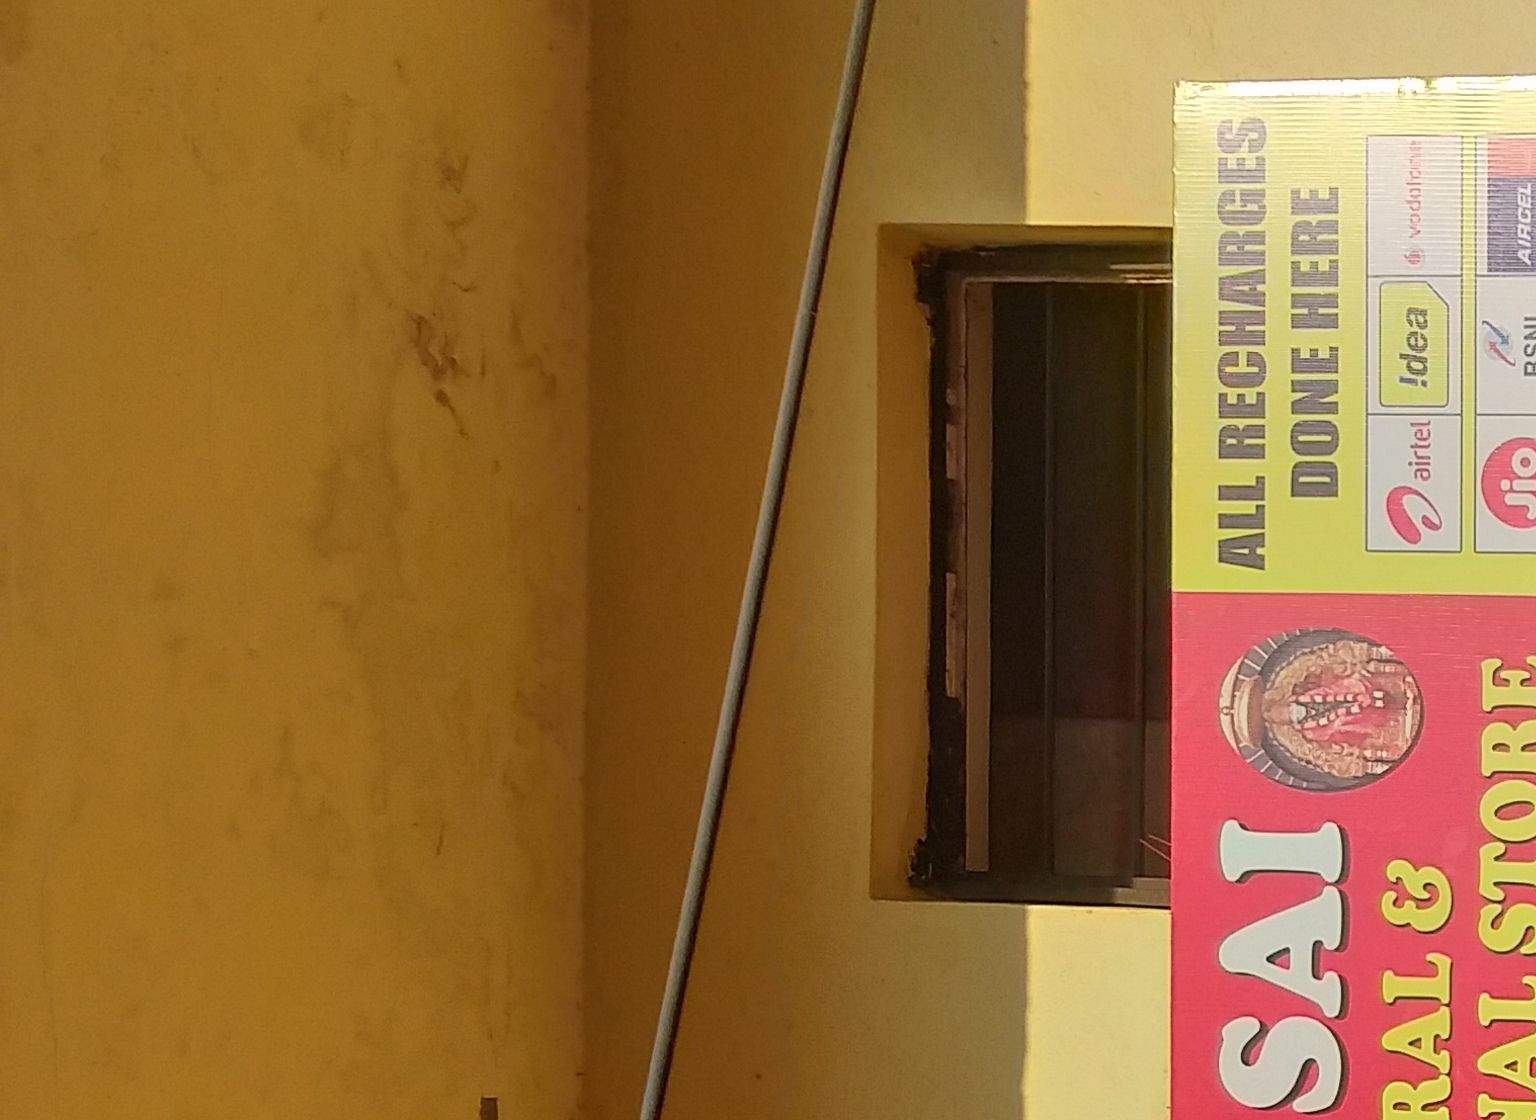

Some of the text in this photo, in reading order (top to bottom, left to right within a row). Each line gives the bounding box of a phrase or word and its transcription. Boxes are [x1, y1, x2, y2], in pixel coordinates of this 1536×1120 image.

[1404, 140, 1423, 239] vodafone
[1516, 182, 1533, 267] AIRCEL
[1216, 115, 1268, 571] ALL RECHARGES
[1290, 185, 1342, 499] DONE HERE
[1409, 419, 1433, 482] airtel
[1382, 858, 1454, 934] &
[1217, 819, 1346, 1114] SAI
